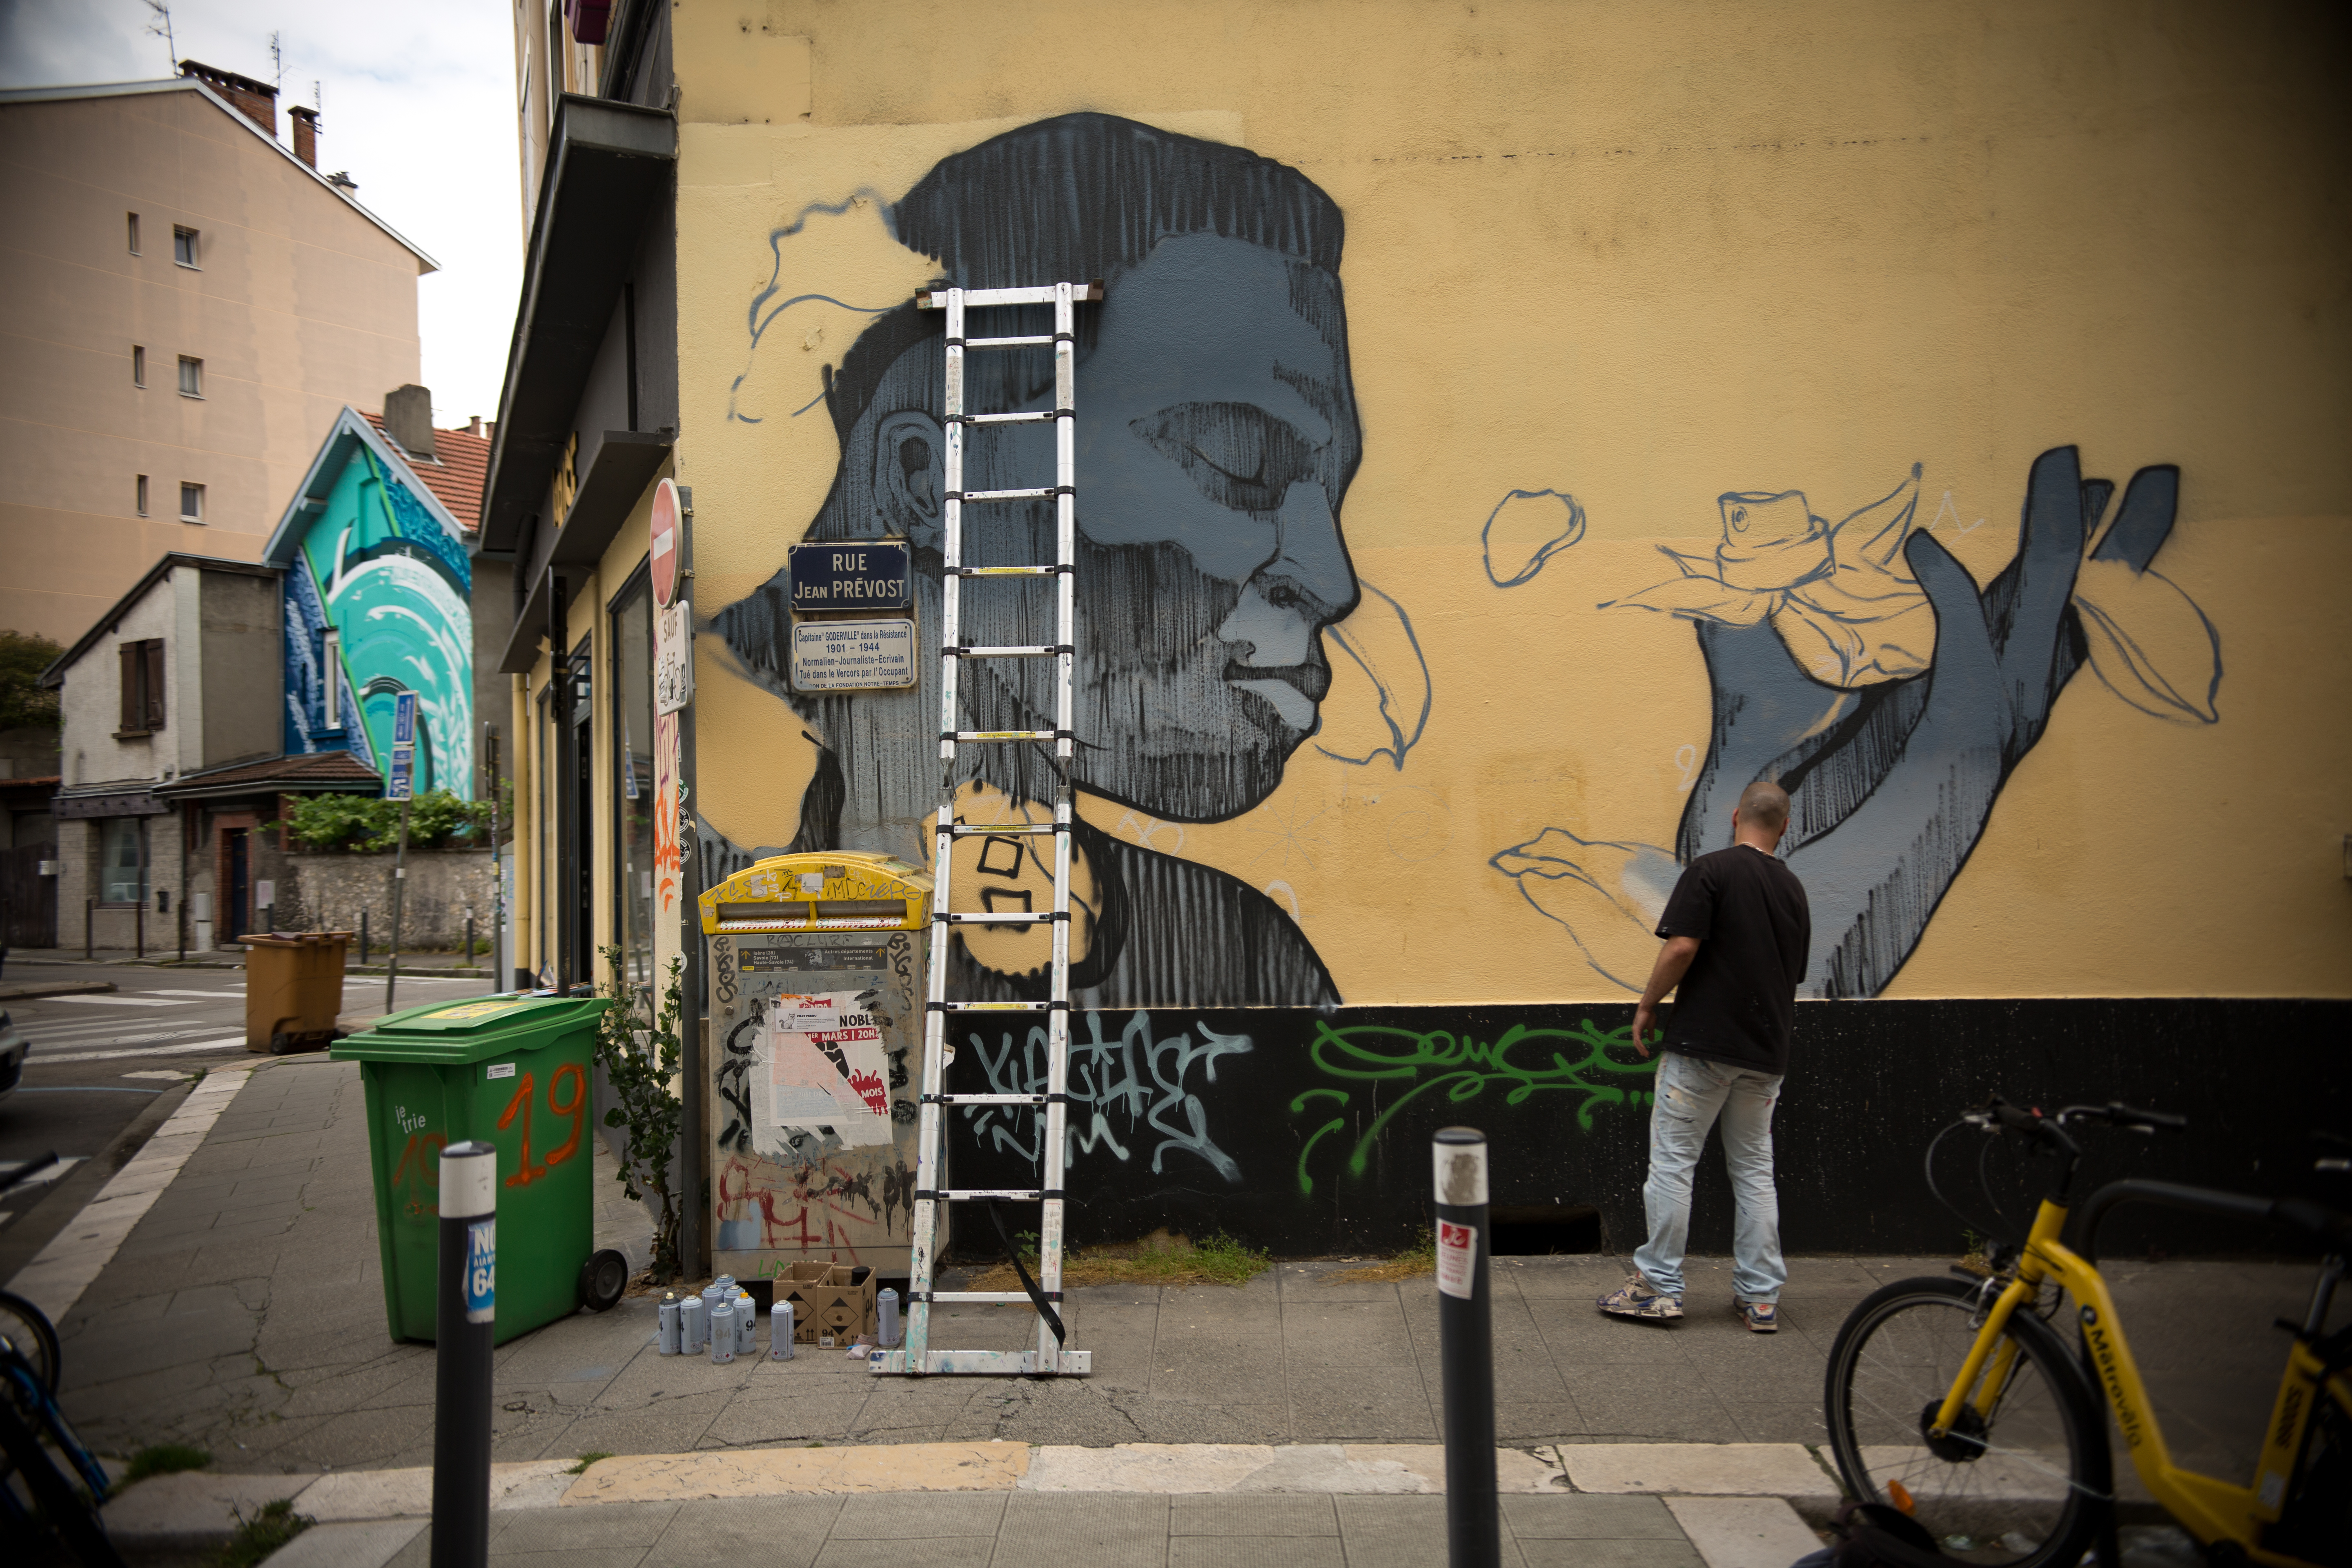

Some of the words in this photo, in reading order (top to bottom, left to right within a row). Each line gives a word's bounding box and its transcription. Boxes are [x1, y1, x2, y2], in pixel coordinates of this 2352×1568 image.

[833, 553, 867, 571] RUE
[833, 577, 904, 598] PRÉVOST
[664, 611, 677, 644] SAUF
[860, 631, 873, 640] dans
[873, 630, 878, 639] la
[880, 630, 907, 639] Résistance
[826, 644, 846, 653] 1901
[859, 642, 880, 652] 1944
[800, 670, 811, 679] Tué
[812, 670, 827, 679] dans
[829, 669, 835, 678] le
[836, 668, 860, 678] Vercors
[862, 669, 871, 679] par
[822, 1031, 848, 1041] MARS
[861, 1087, 883, 1098] MOIS
[395, 1105, 406, 1124] je
[402, 1114, 426, 1134] trie
[497, 1063, 587, 1187] 19
[473, 1265, 495, 1297] 64
[865, 1293, 873, 1319] 94
[715, 1327, 731, 1341] 94
[822, 1329, 834, 1337] 94
